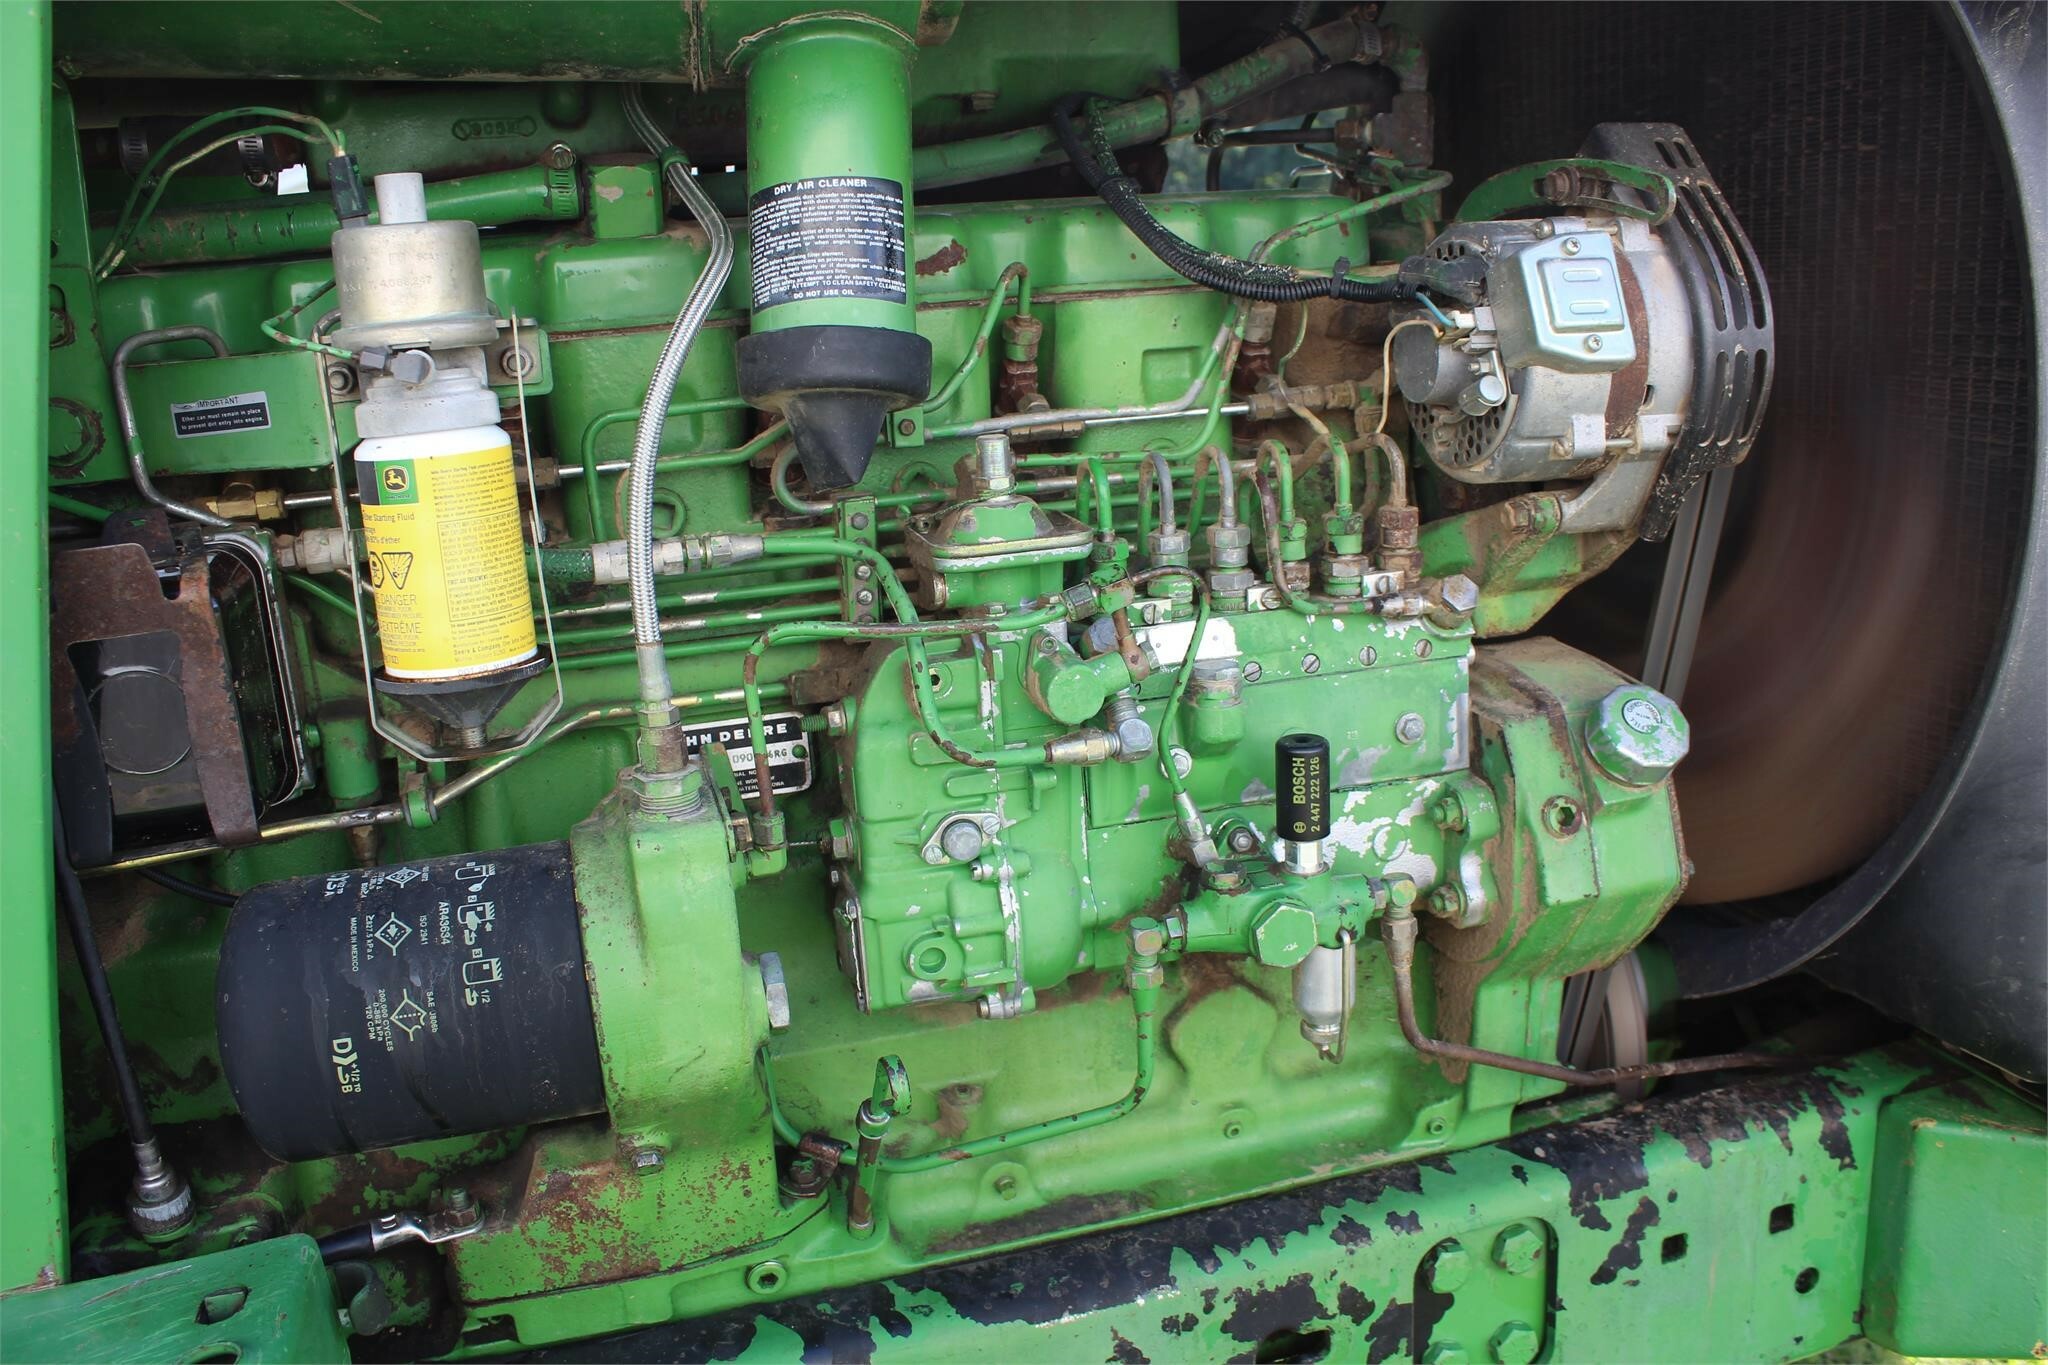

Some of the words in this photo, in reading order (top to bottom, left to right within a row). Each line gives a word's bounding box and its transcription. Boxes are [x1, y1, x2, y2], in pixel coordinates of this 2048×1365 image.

[774, 181, 792, 195] DRY
[796, 178, 814, 190] AIR
[818, 178, 867, 188] CLEANER
[794, 291, 805, 300] DO
[806, 290, 821, 298] NOT
[824, 289, 839, 297] USE
[841, 288, 854, 296] OIL
[878, 282, 900, 290] CLEANER
[197, 397, 239, 408] IMPORTANT
[247, 408, 261, 416] place
[188, 422, 206, 430] prevent
[373, 513, 396, 523] Starting
[397, 512, 415, 521] Fluid
[686, 733, 712, 747] HN
[719, 723, 788, 742] DERE
[1310, 756, 1320, 777] 126
[1292, 757, 1306, 805] BOSCH
[1310, 778, 1320, 799] 222
[1311, 803, 1320, 821] 447
[1311, 825, 1320, 833] 2
[350, 917, 358, 936] MADE
[419, 915, 427, 927] ISO
[438, 901, 451, 946] AR43634
[366, 938, 374, 953] kPa
[420, 929, 428, 946] 2941
[351, 944, 359, 972] MEXICO
[426, 991, 435, 1008] SAE
[481, 989, 490, 1004] 1/2
[364, 1005, 373, 1020] 120
[377, 988, 387, 1018] 200,000
[382, 1019, 394, 1052] CYCLES
[367, 1020, 376, 1040] CPM
[428, 1011, 438, 1033] J806b
[375, 1025, 384, 1041] kPa
[340, 1083, 353, 1093] B
[353, 1082, 362, 1093] TO
